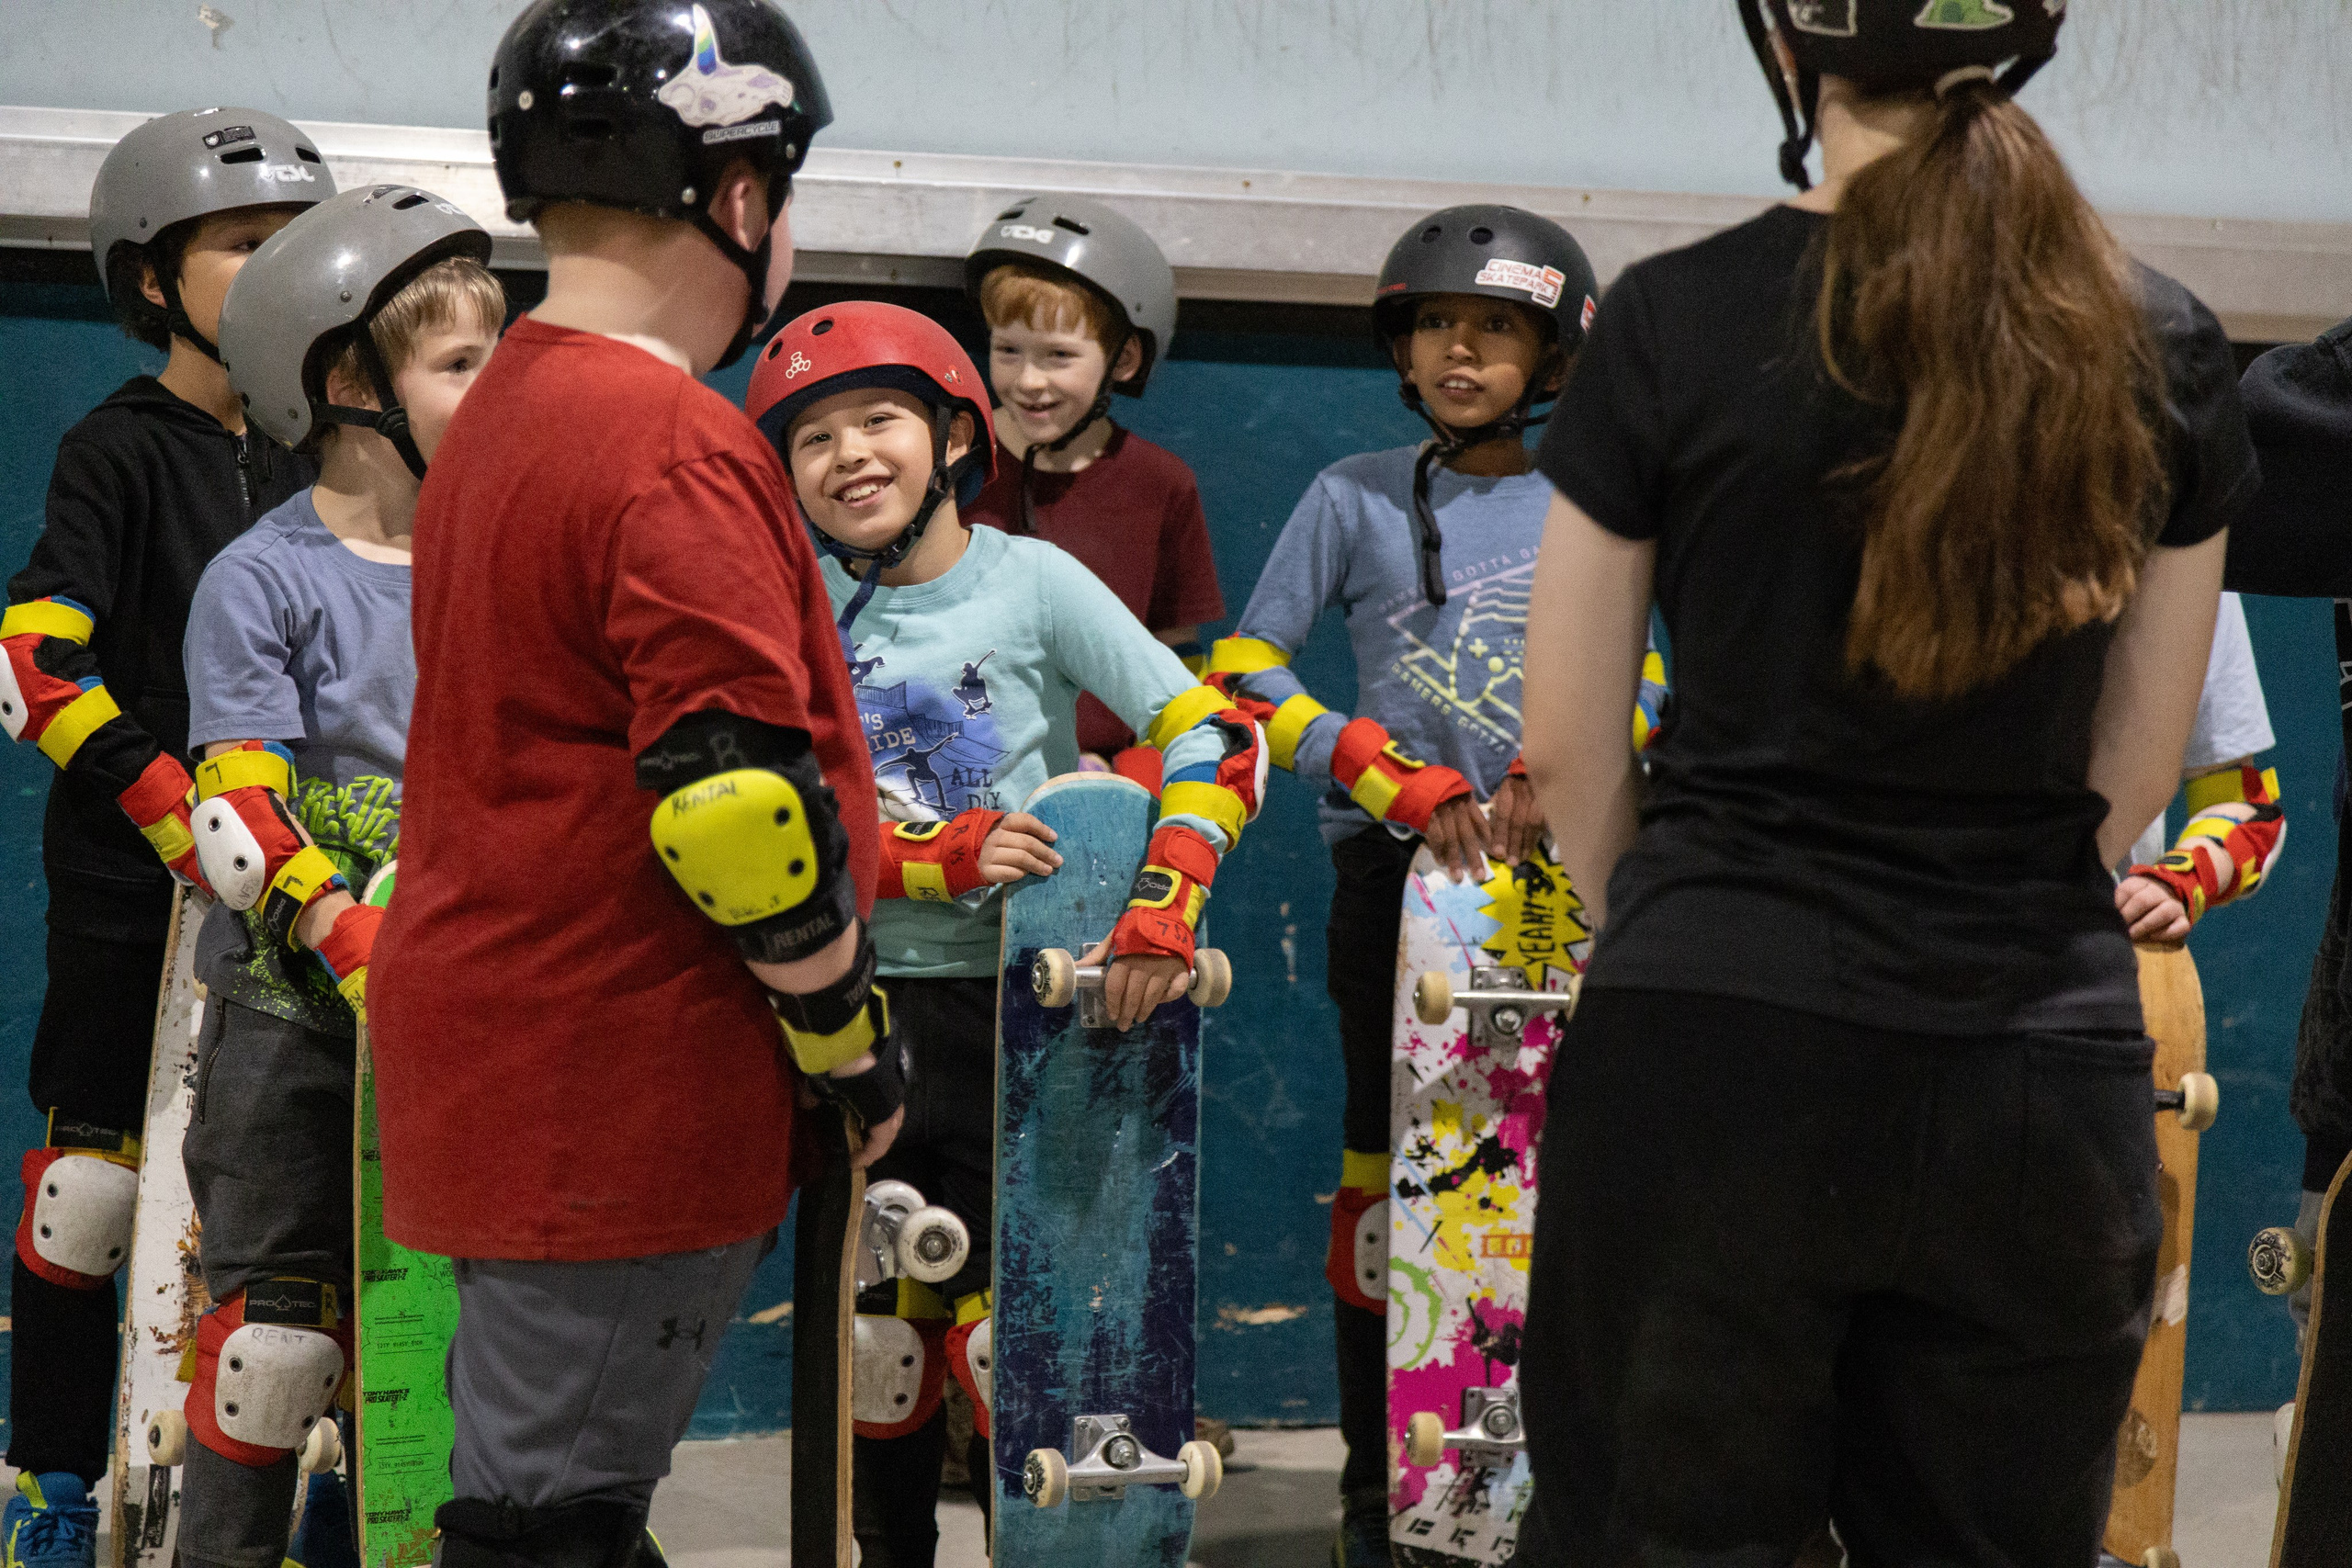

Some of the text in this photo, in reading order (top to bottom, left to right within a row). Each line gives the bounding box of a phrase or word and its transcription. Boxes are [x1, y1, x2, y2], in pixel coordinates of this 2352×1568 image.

[705, 121, 778, 141] SUPERCYCLE
[1488, 261, 1541, 279] CINEMA
[1478, 272, 1548, 293] SKATEPARK
[1452, 555, 1512, 581] GOTTA
[1391, 662, 1506, 752] GAMERS GOTTA
[950, 767, 993, 788] ALL
[672, 779, 738, 818] RENTAL
[1148, 881, 1171, 892] PRO
[1517, 900, 1555, 966] YEAH!
[376, 1273, 398, 1281] SKATER
[249, 1299, 275, 1307] PRO
[252, 1327, 308, 1345] RENT
[377, 1394, 399, 1403] SKATER
